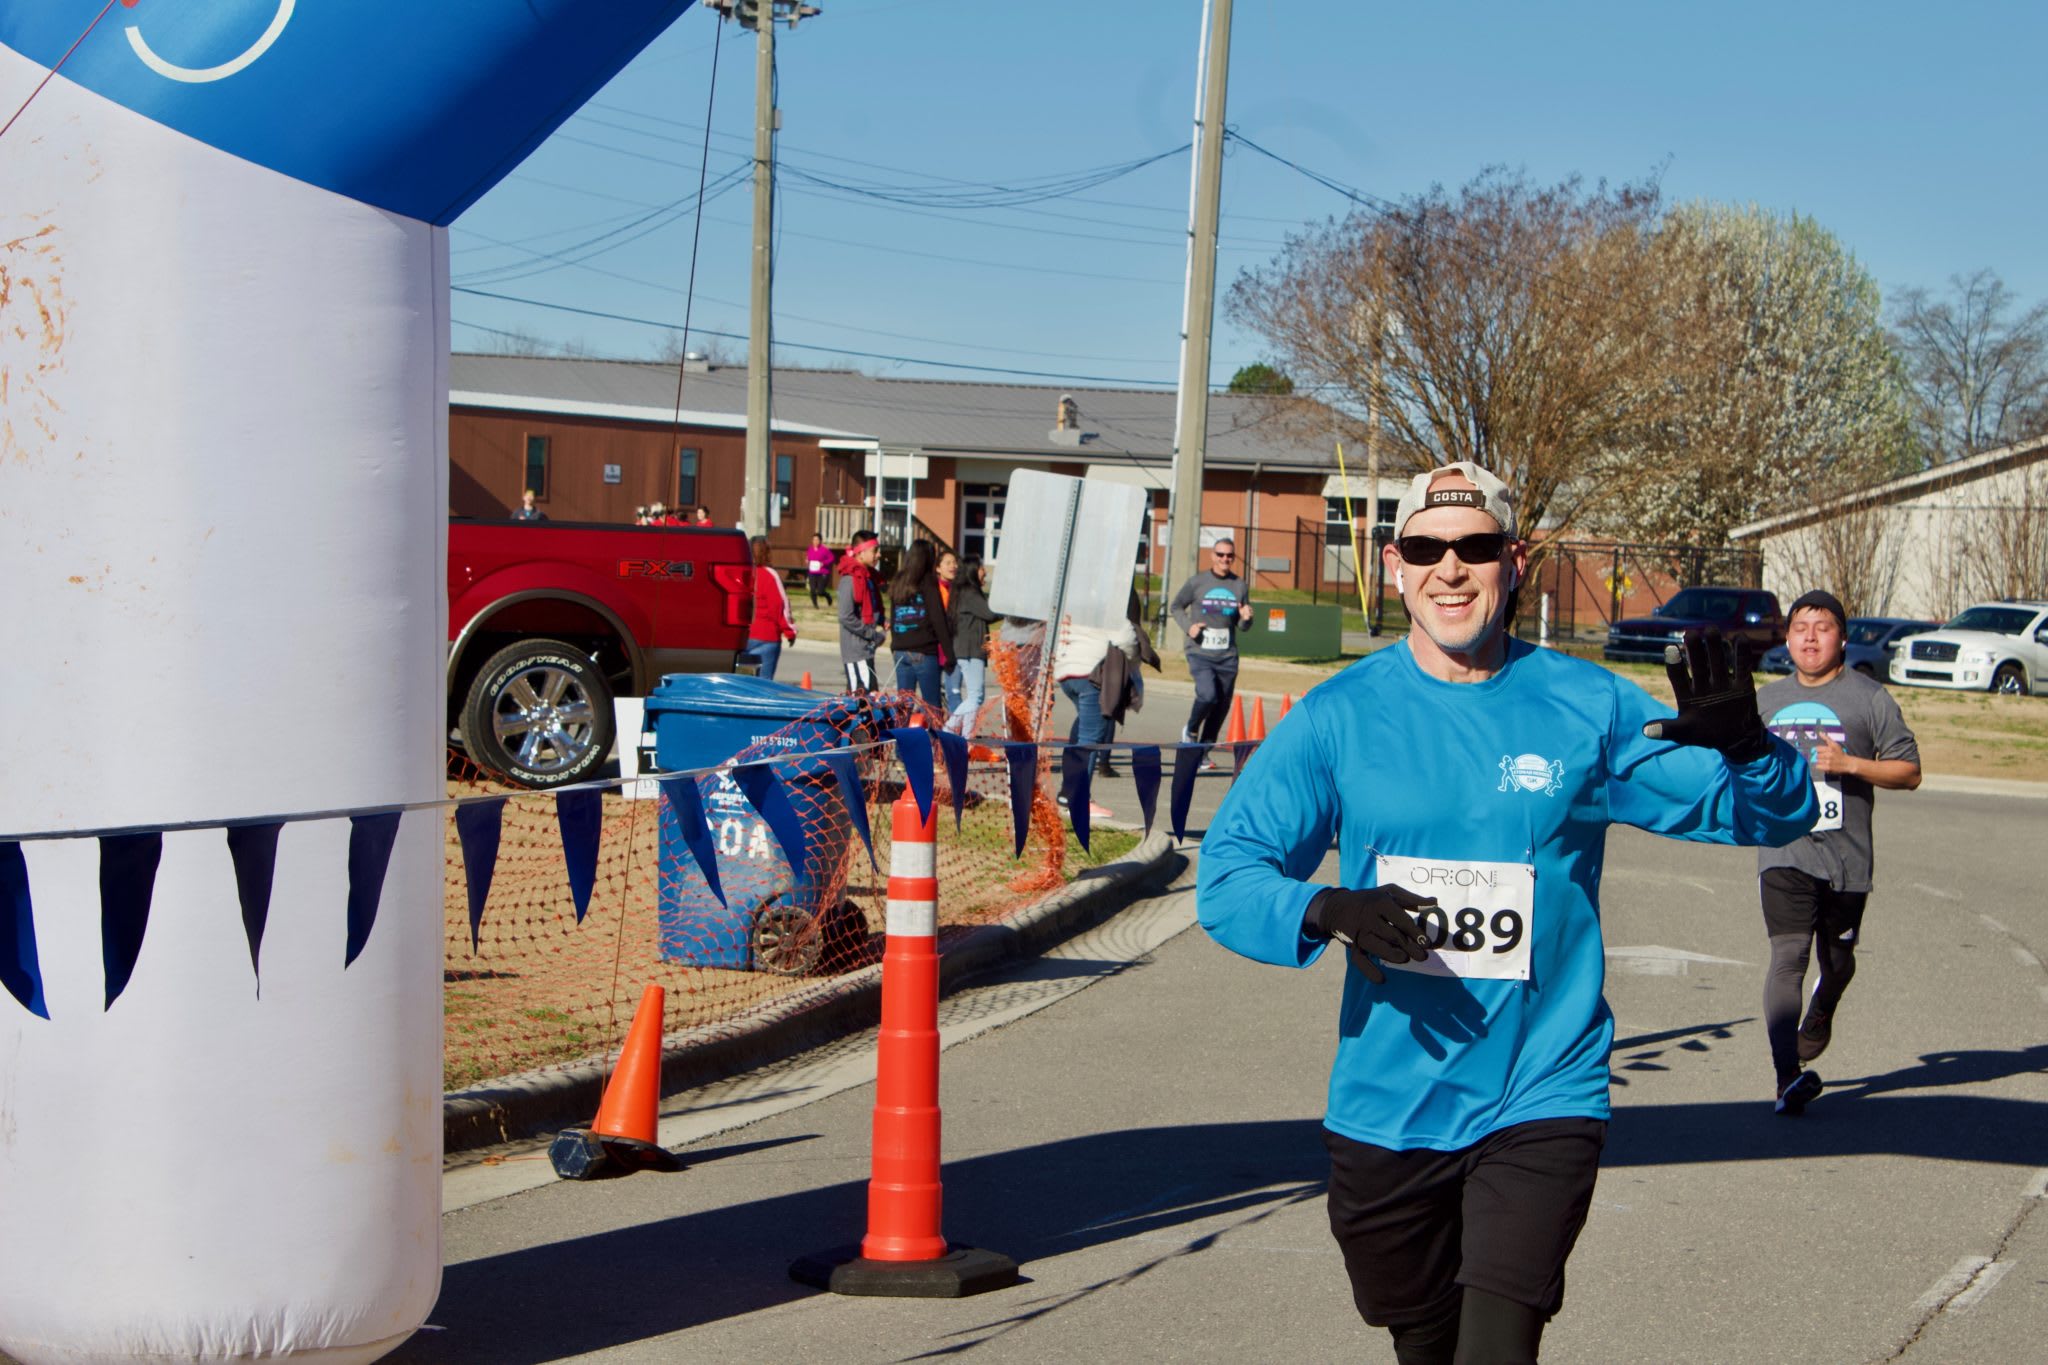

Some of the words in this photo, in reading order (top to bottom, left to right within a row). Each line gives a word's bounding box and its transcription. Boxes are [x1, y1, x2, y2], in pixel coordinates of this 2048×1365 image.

[1433, 491, 1473, 502] COSTA
[618, 560, 693, 579] FX4
[490, 655, 583, 697] GOODYEAR
[510, 744, 601, 783] WRANGLER
